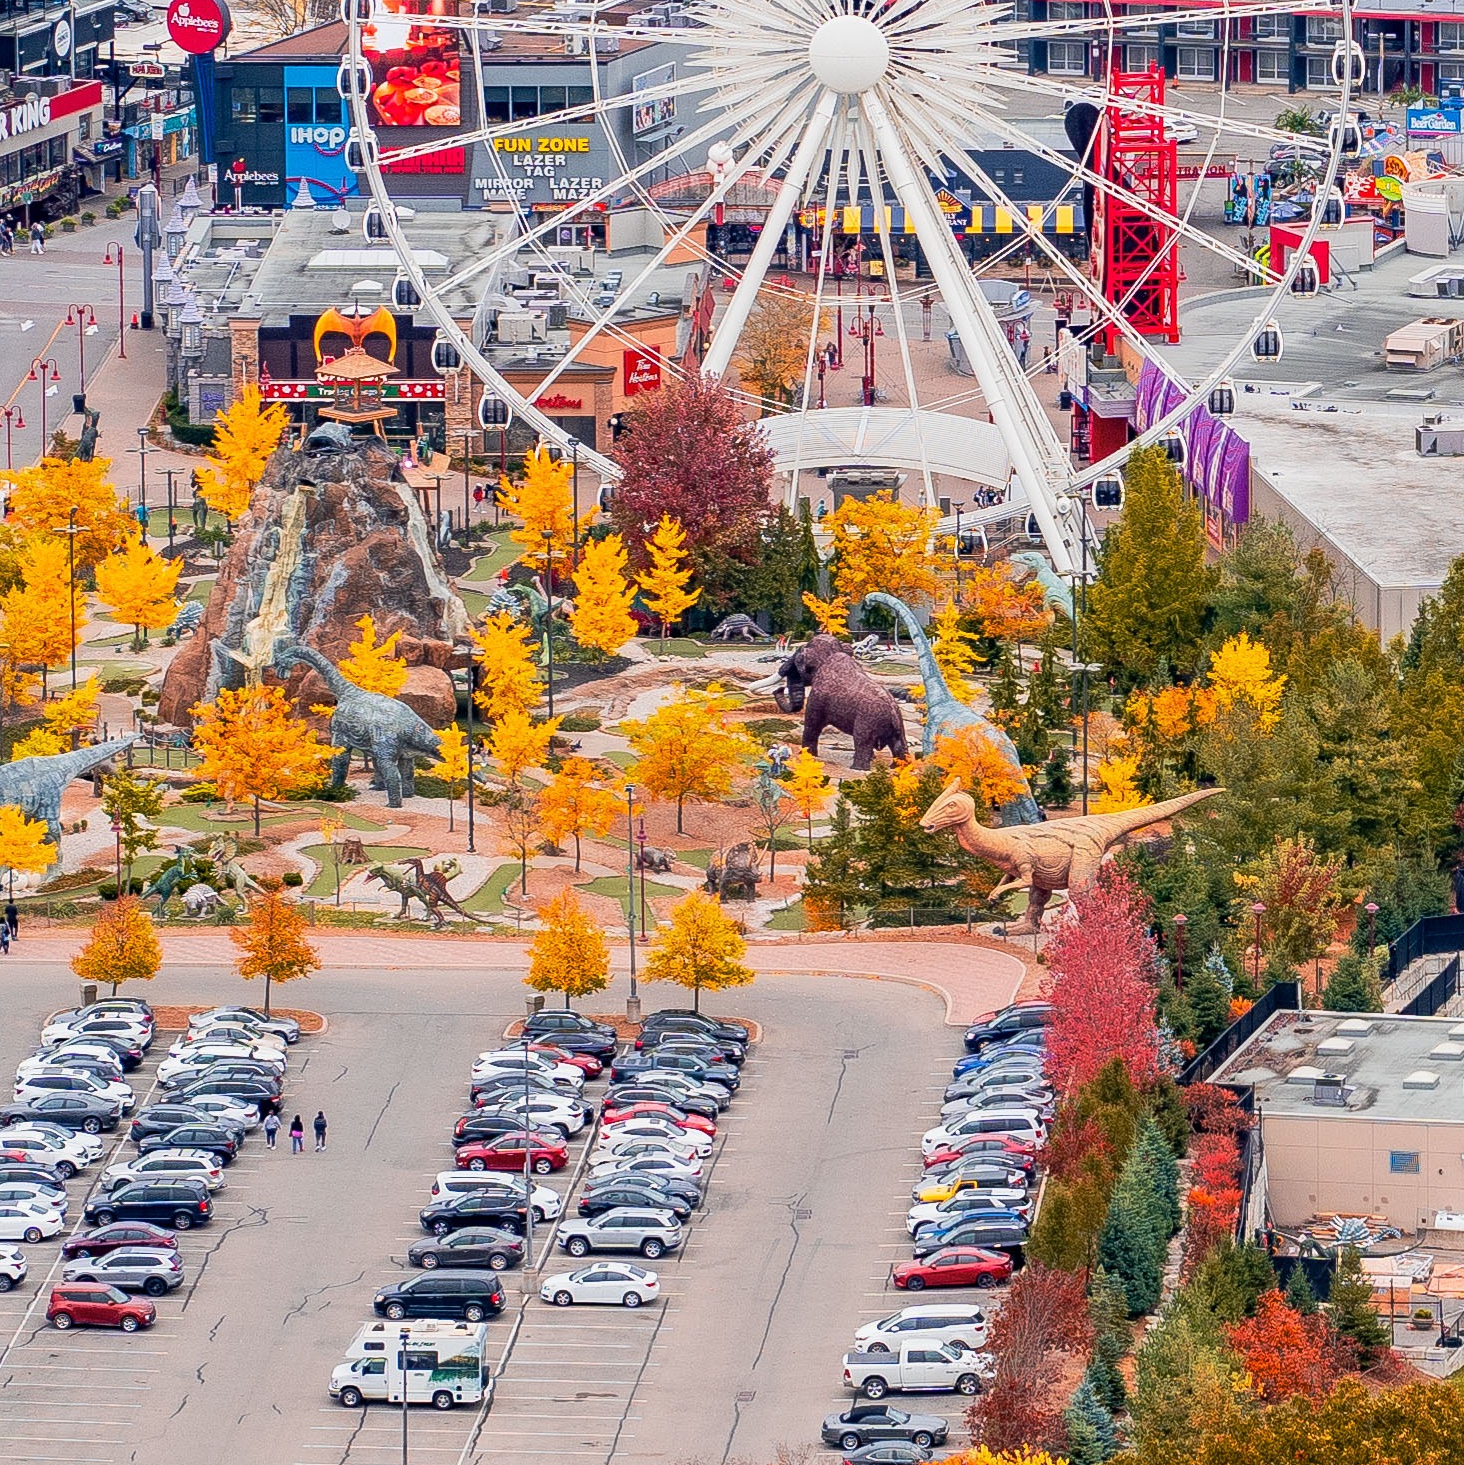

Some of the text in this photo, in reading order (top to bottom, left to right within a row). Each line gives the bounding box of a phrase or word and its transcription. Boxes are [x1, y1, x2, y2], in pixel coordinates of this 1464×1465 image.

[171, 12, 219, 29] Applebee's
[10, 97, 51, 136] KING
[494, 138, 590, 153] FUN ZONE
[513, 154, 566, 166] LAZER
[224, 169, 279, 183] Applebee's
[525, 166, 556, 177] TAG
[550, 178, 603, 189] LAZER
[532, 393, 582, 410] ortons
